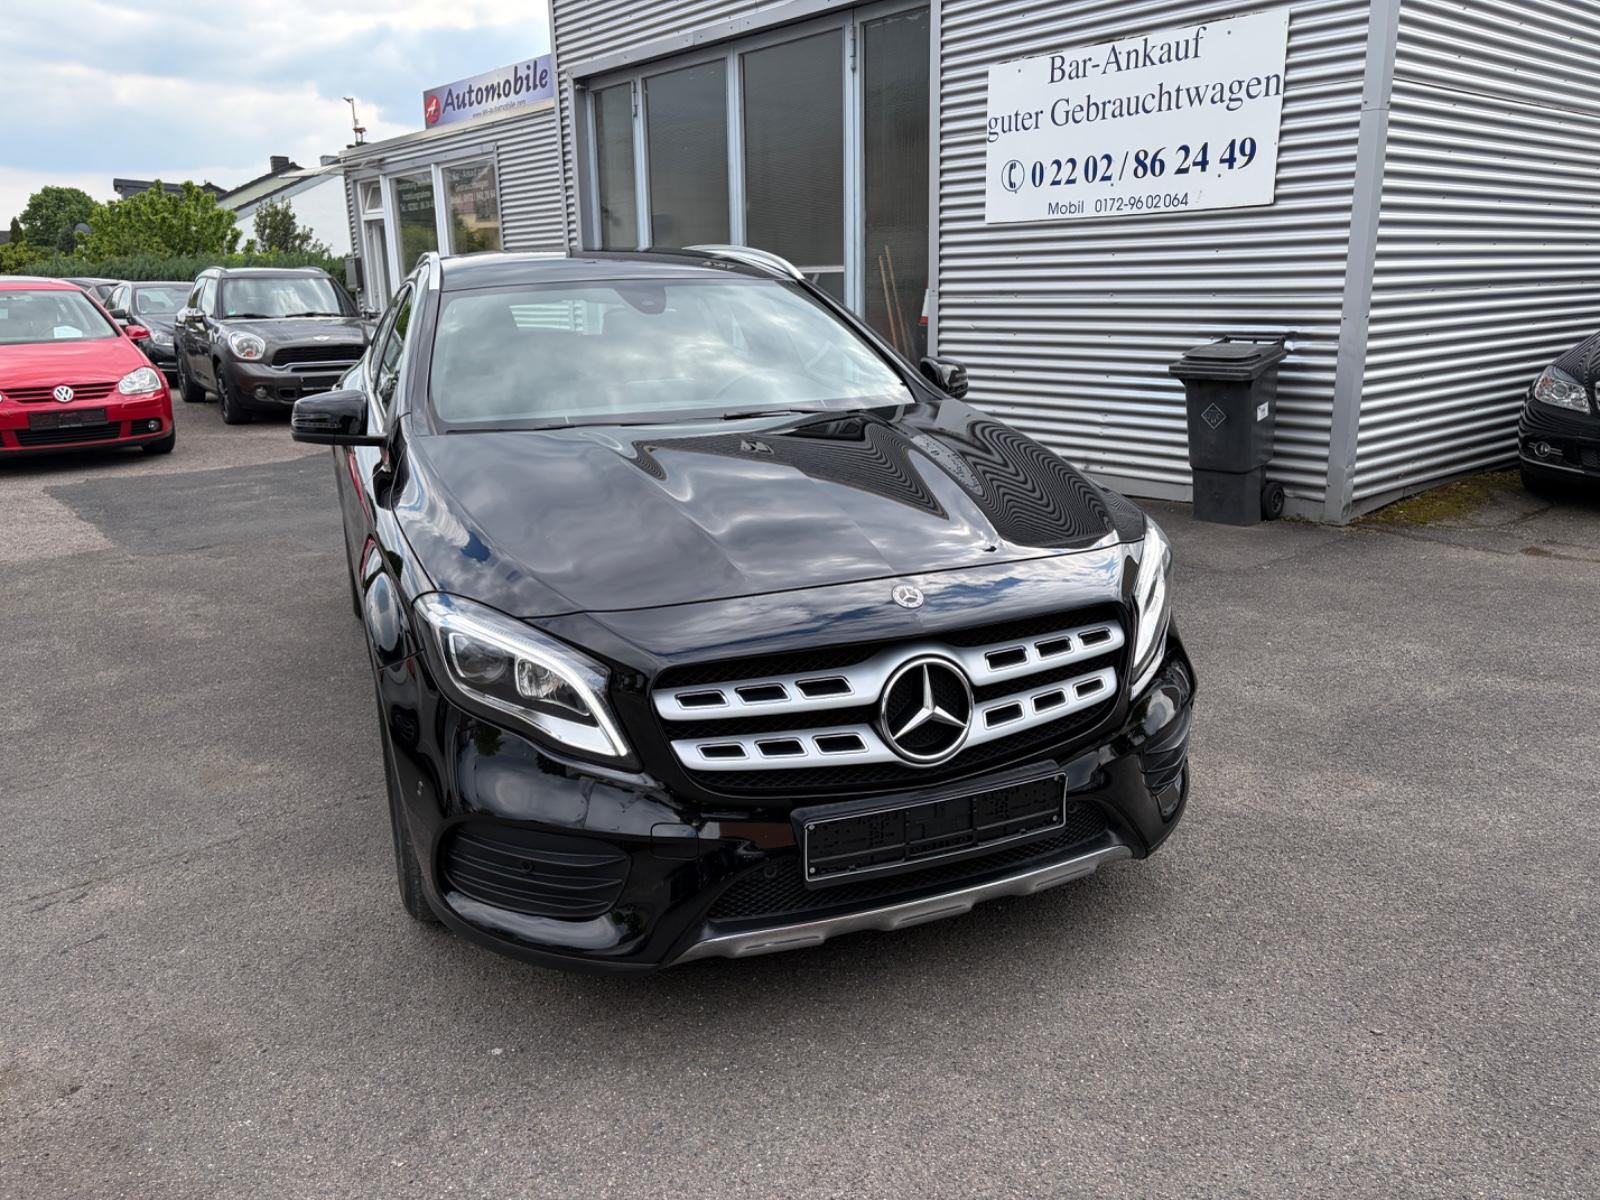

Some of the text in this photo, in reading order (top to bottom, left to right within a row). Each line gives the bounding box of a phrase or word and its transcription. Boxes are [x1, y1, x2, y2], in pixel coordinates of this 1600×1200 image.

[1048, 26, 1207, 84] Bar-Ankauf
[442, 60, 549, 114] Automobile
[986, 73, 1282, 143] guter Gebrauchtwagen
[1048, 200, 1084, 216] Mobil
